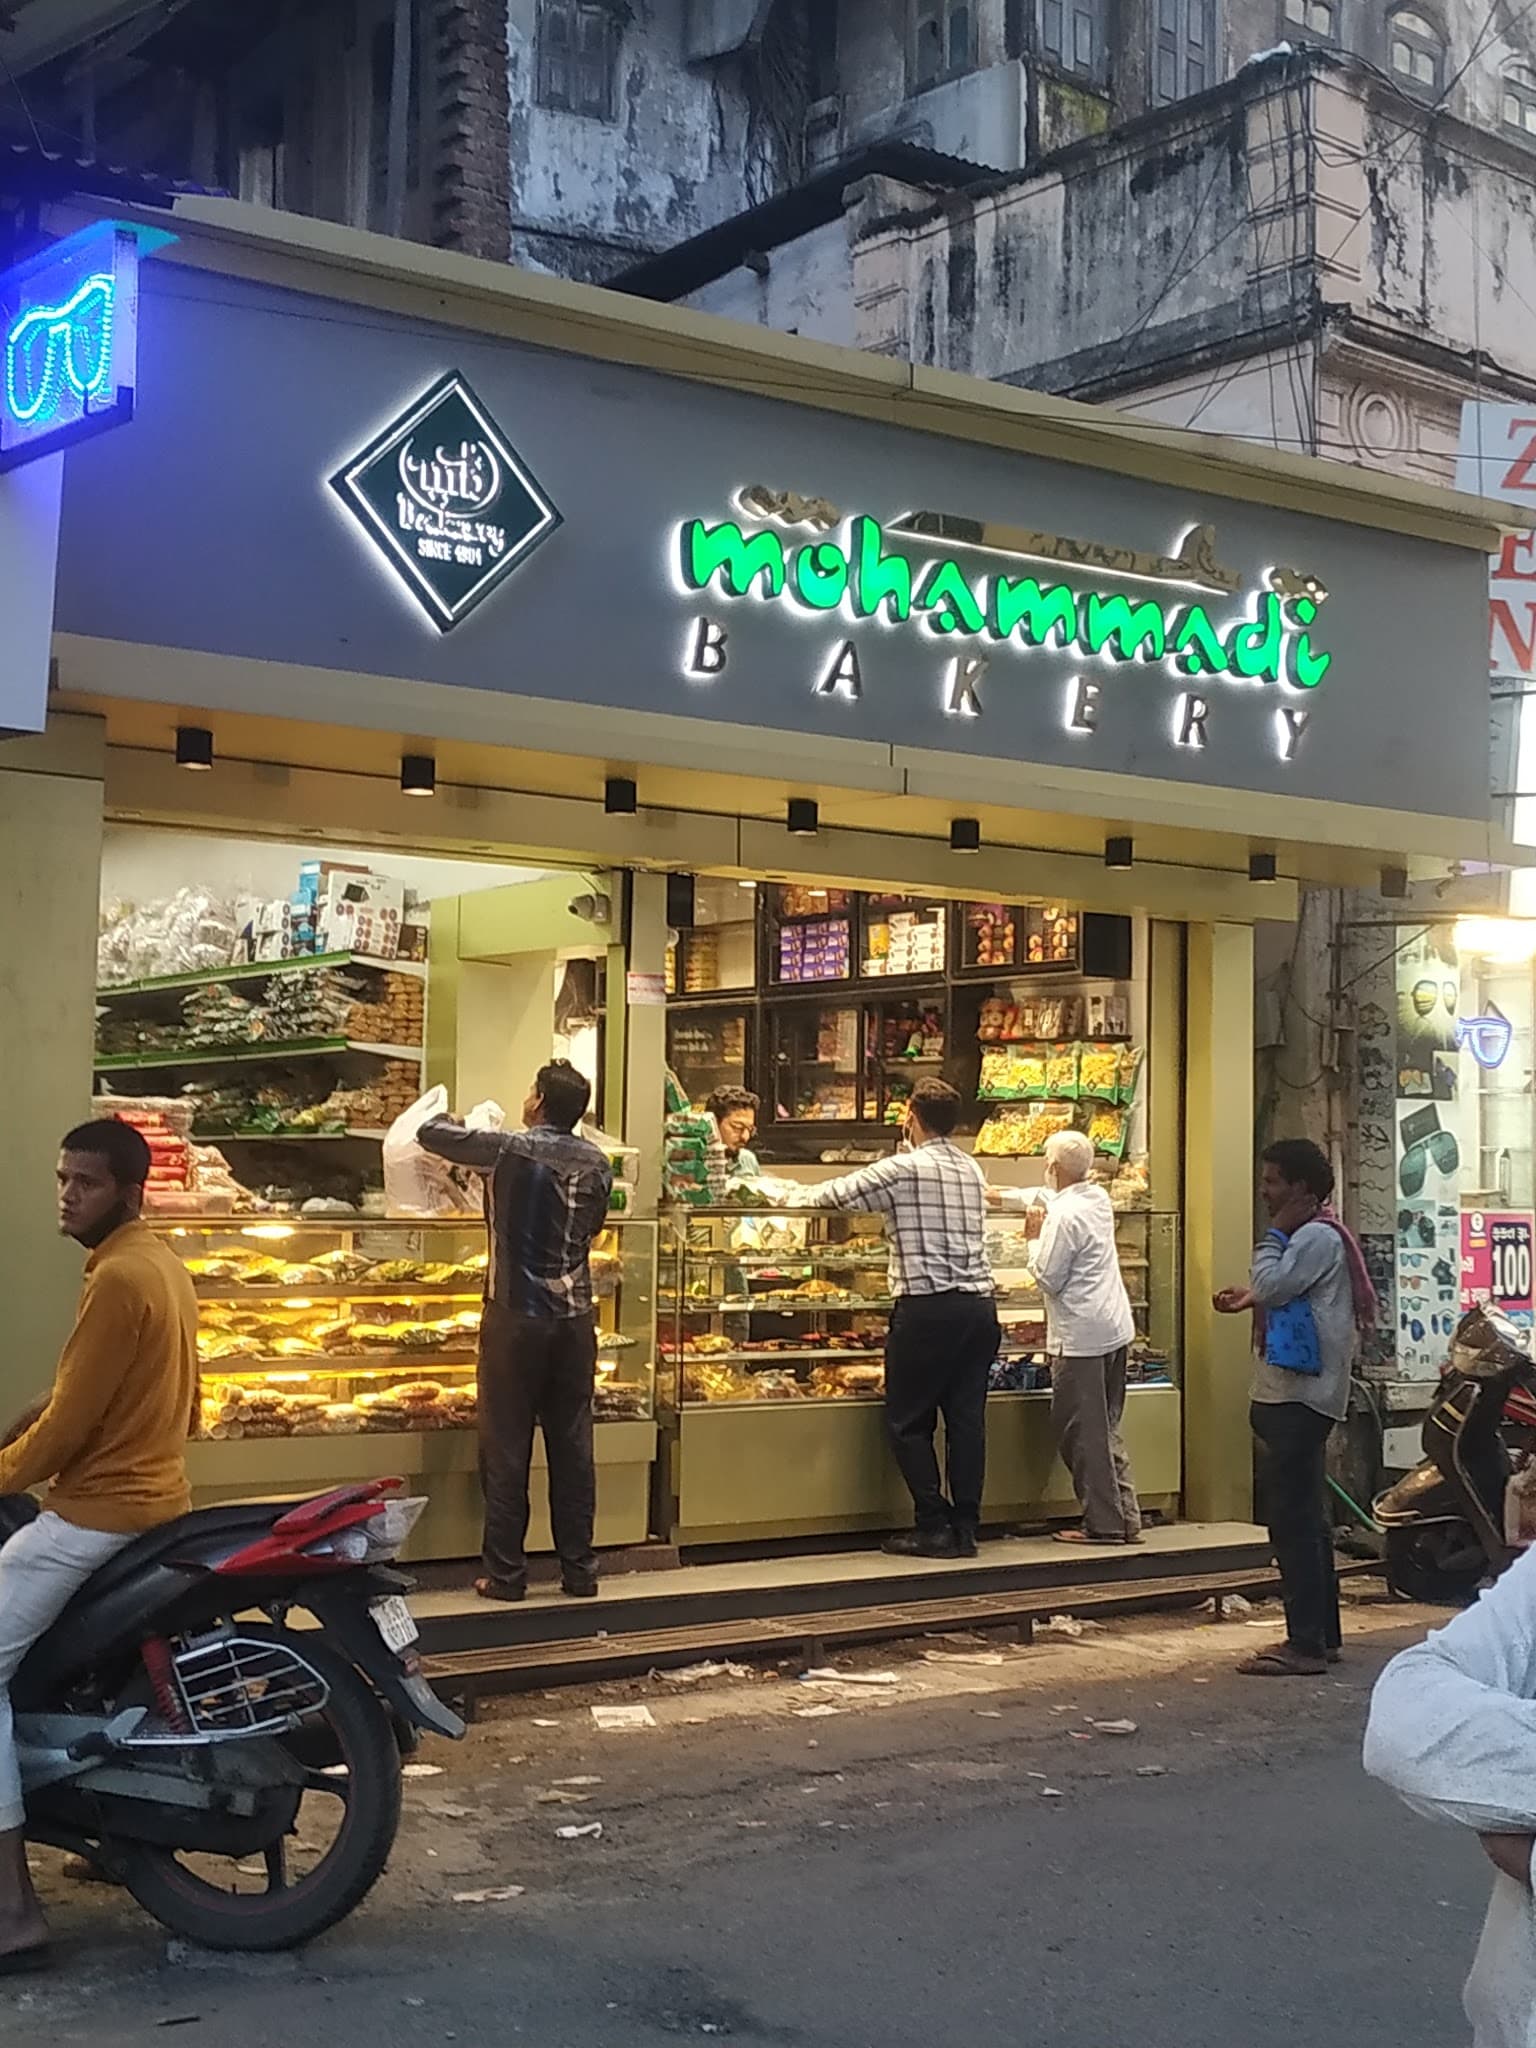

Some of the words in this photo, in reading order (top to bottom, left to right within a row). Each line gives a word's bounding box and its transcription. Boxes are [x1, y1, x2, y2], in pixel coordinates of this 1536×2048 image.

[680, 515, 1331, 690] mohammadi
[688, 616, 1309, 761] BAKERY
[1492, 1244, 1531, 1297] 100
